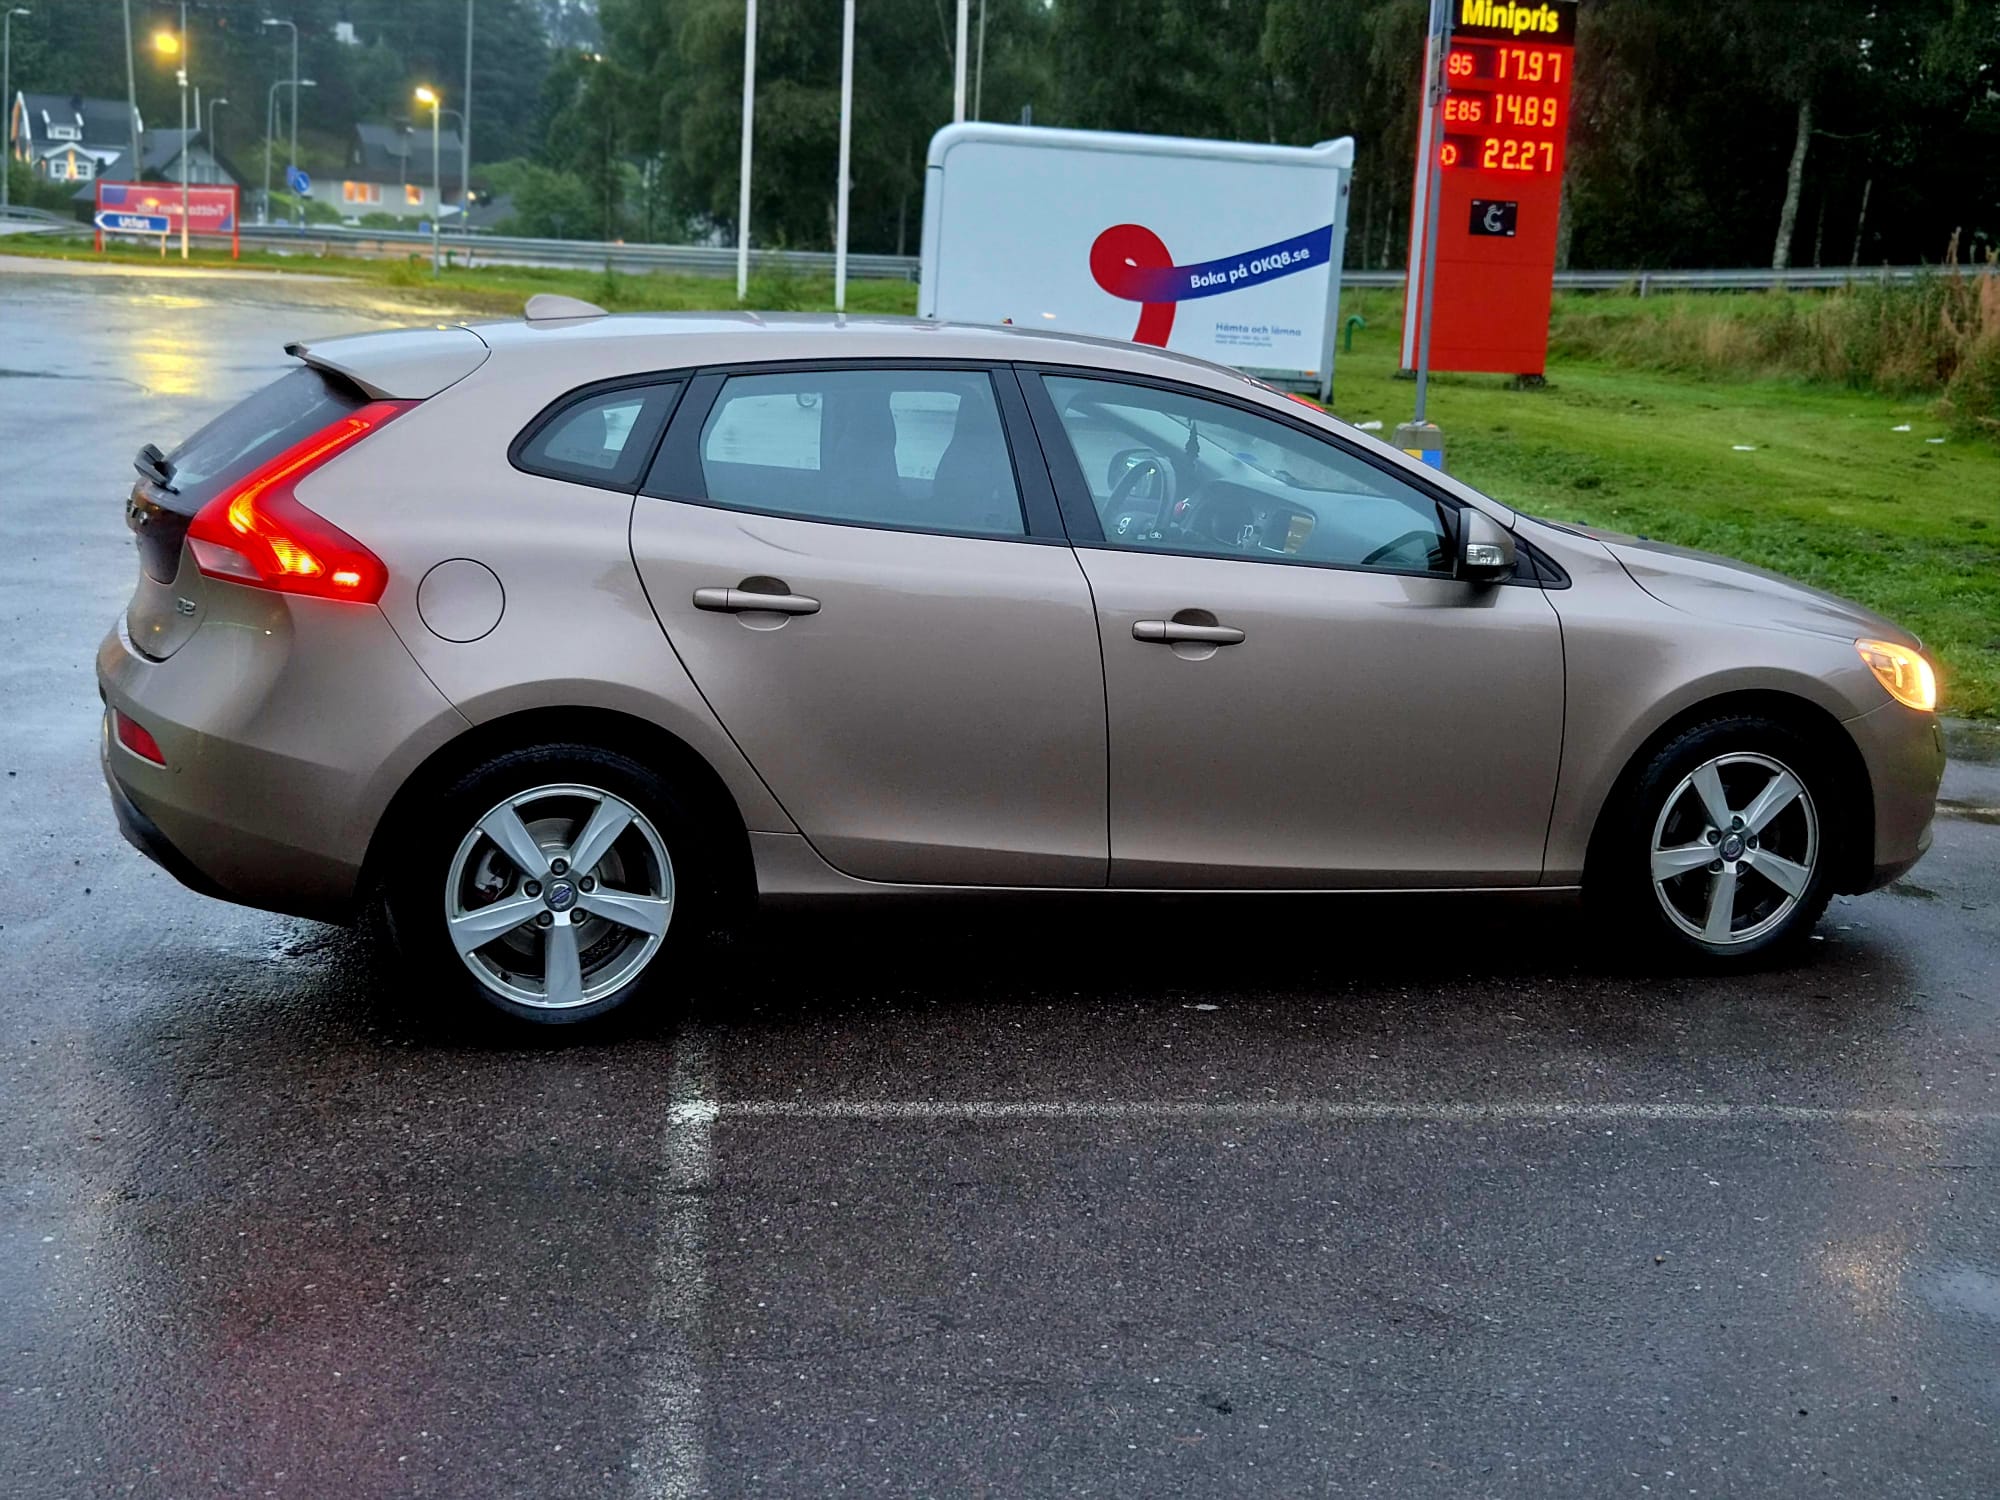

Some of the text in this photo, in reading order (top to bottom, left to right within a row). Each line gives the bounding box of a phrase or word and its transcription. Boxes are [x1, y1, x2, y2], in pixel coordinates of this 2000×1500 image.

[1462, 0, 1559, 35] Minipris
[1448, 48, 1562, 83] 95 17.97
[1444, 94, 1558, 127] E85 14.89
[1483, 138, 1554, 172] 22.27
[1190, 248, 1310, 288] Boka på OKQ8.se
[1251, 326, 1269, 335] och
